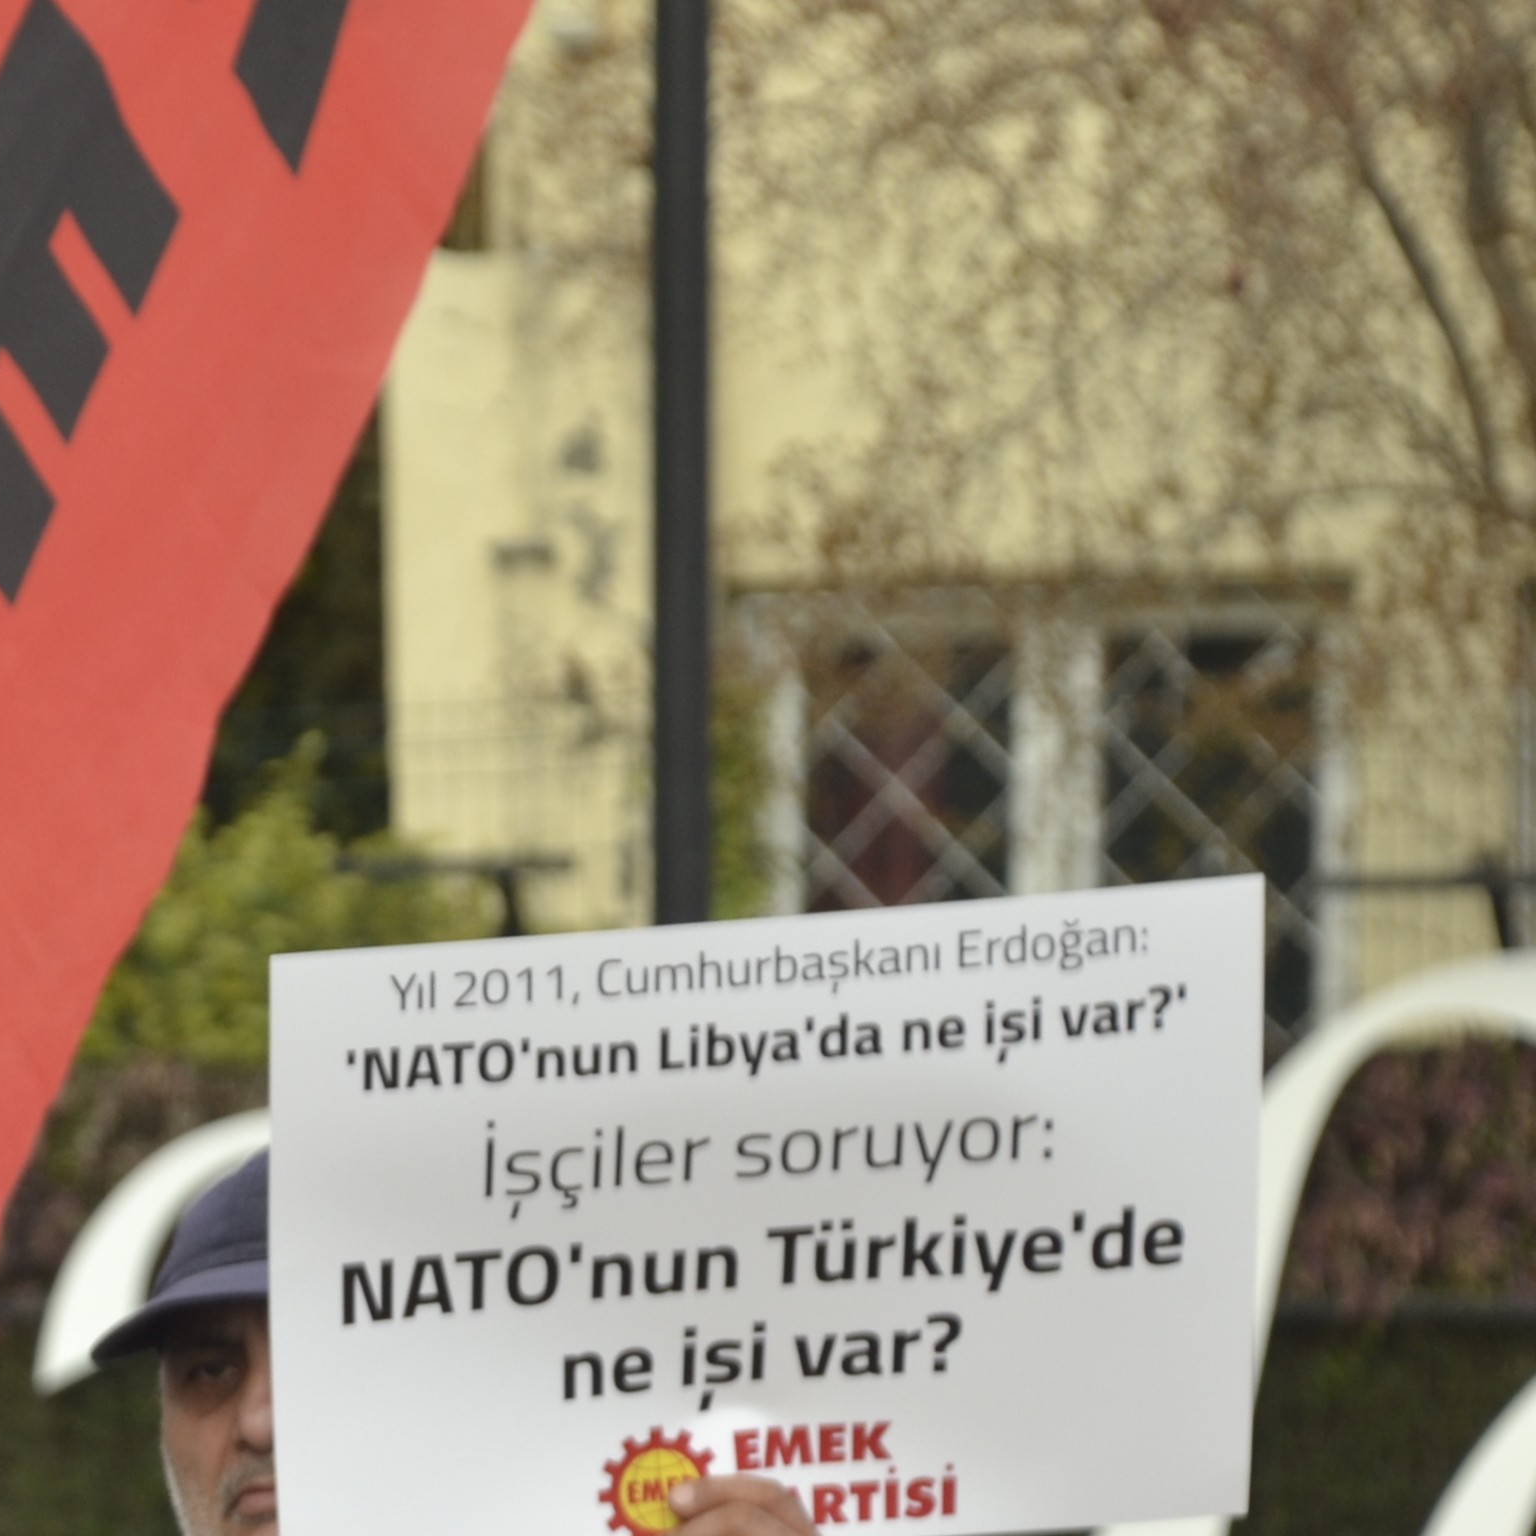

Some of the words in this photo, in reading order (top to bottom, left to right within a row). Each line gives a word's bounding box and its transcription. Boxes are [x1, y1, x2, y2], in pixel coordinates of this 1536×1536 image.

[390, 971, 436, 1011] Yıl
[453, 965, 579, 1009] 2011,
[596, 939, 941, 998] Cumhurbaşkanı
[956, 917, 1150, 972] Erdoğan:
[347, 1039, 638, 1091] 'NATO'nun
[659, 1014, 882, 1075] Libya'da
[903, 1017, 965, 1052] ne
[985, 997, 1041, 1064] işi
[1061, 985, 1186, 1038] var?'
[484, 1121, 710, 1220] İşçiler
[736, 1116, 1053, 1184] soruyor:
[342, 1244, 738, 1325] NATO'nun
[767, 1207, 1183, 1292] Türkiye'de
[563, 1348, 653, 1400] ne
[682, 1322, 766, 1411] işi
[795, 1313, 962, 1378] var?
[734, 1422, 890, 1472] EMEK
